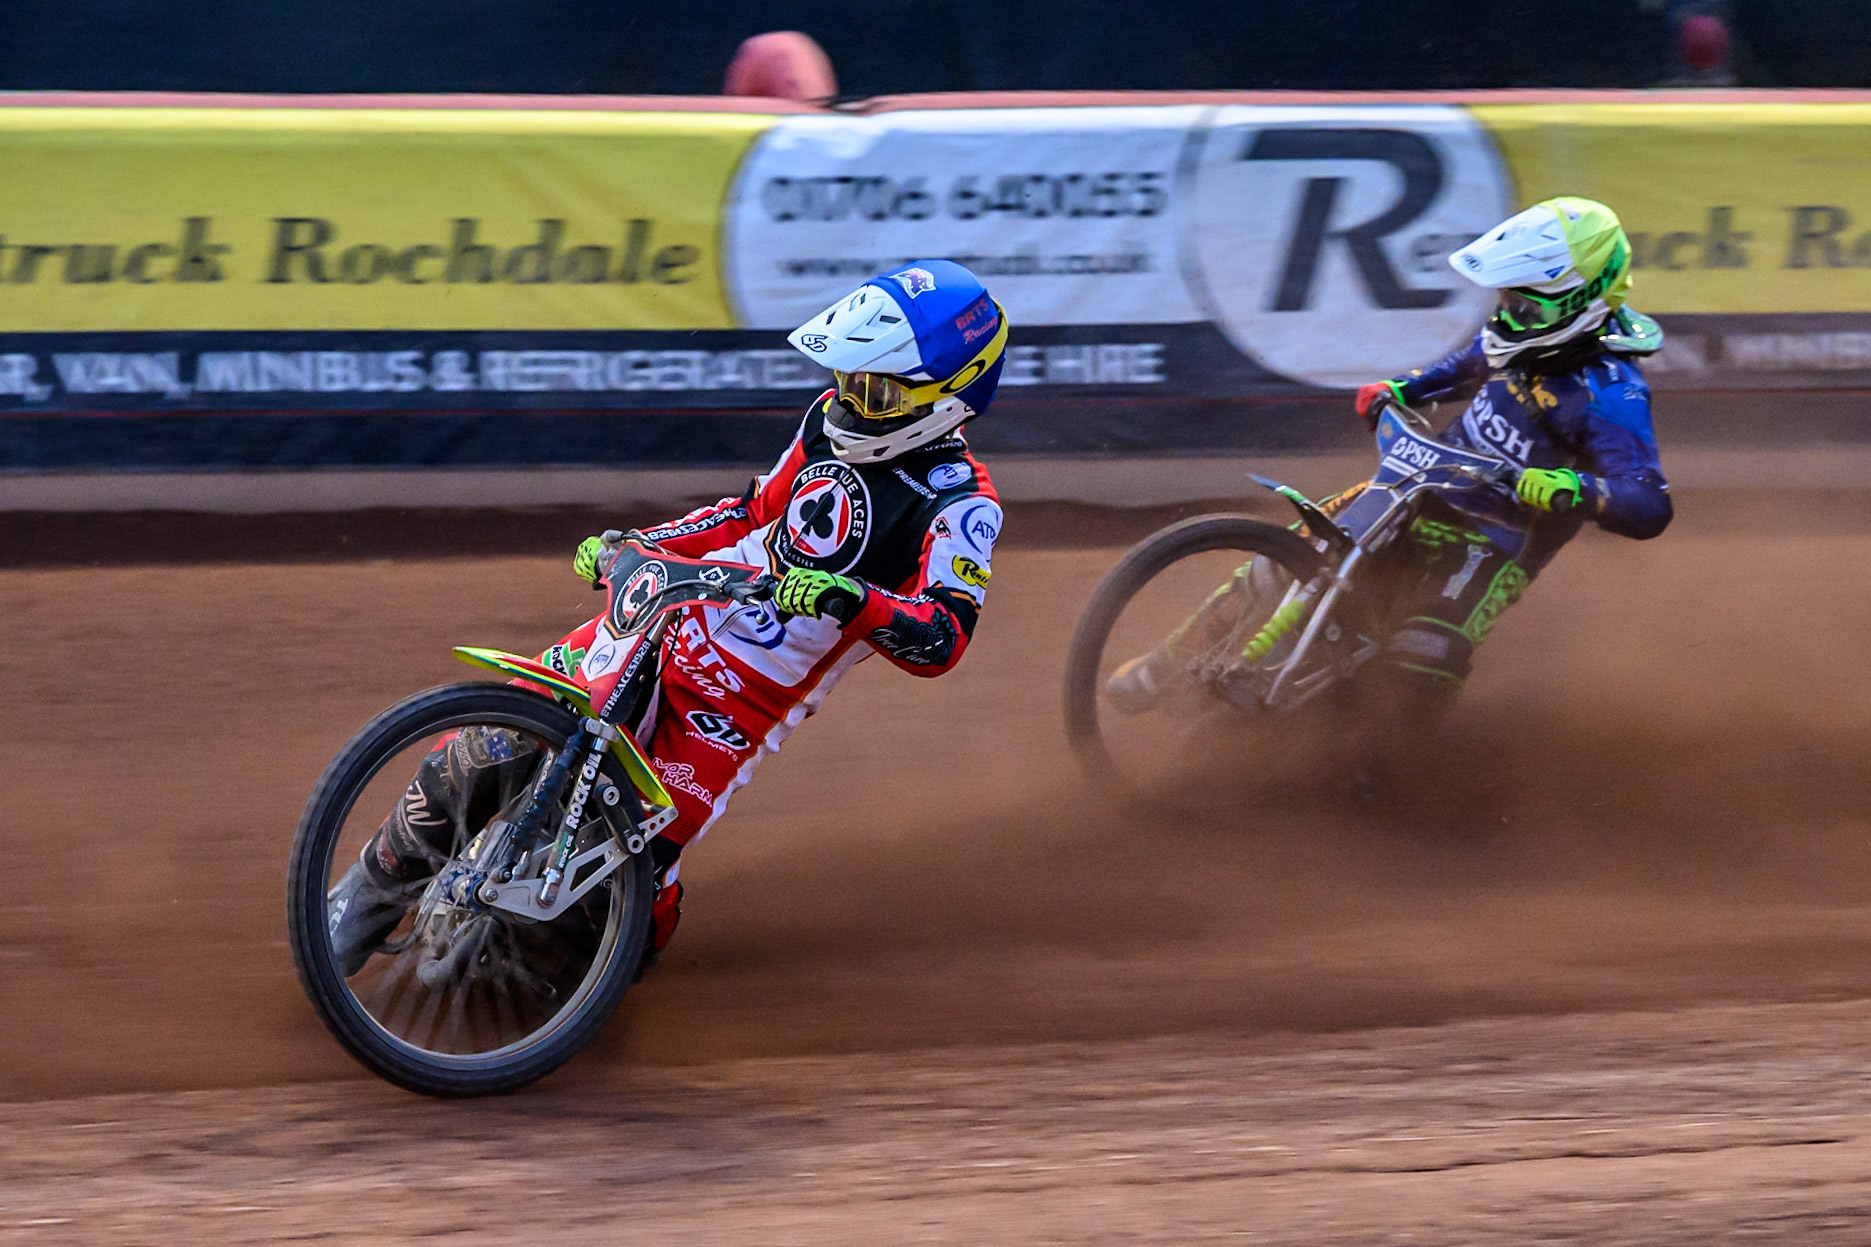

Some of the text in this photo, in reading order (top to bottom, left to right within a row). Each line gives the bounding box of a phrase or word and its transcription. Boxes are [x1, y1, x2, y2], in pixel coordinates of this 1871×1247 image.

[263, 215, 704, 285] Rochdale
[801, 333, 828, 353] 6D
[198, 350, 426, 392] MINIBUS
[430, 350, 478, 392] &
[800, 466, 865, 539] BELLE VUE ACES
[685, 730, 739, 762] HELMETS
[566, 752, 602, 830] ROCK OIL
[559, 850, 570, 868] ROCK
